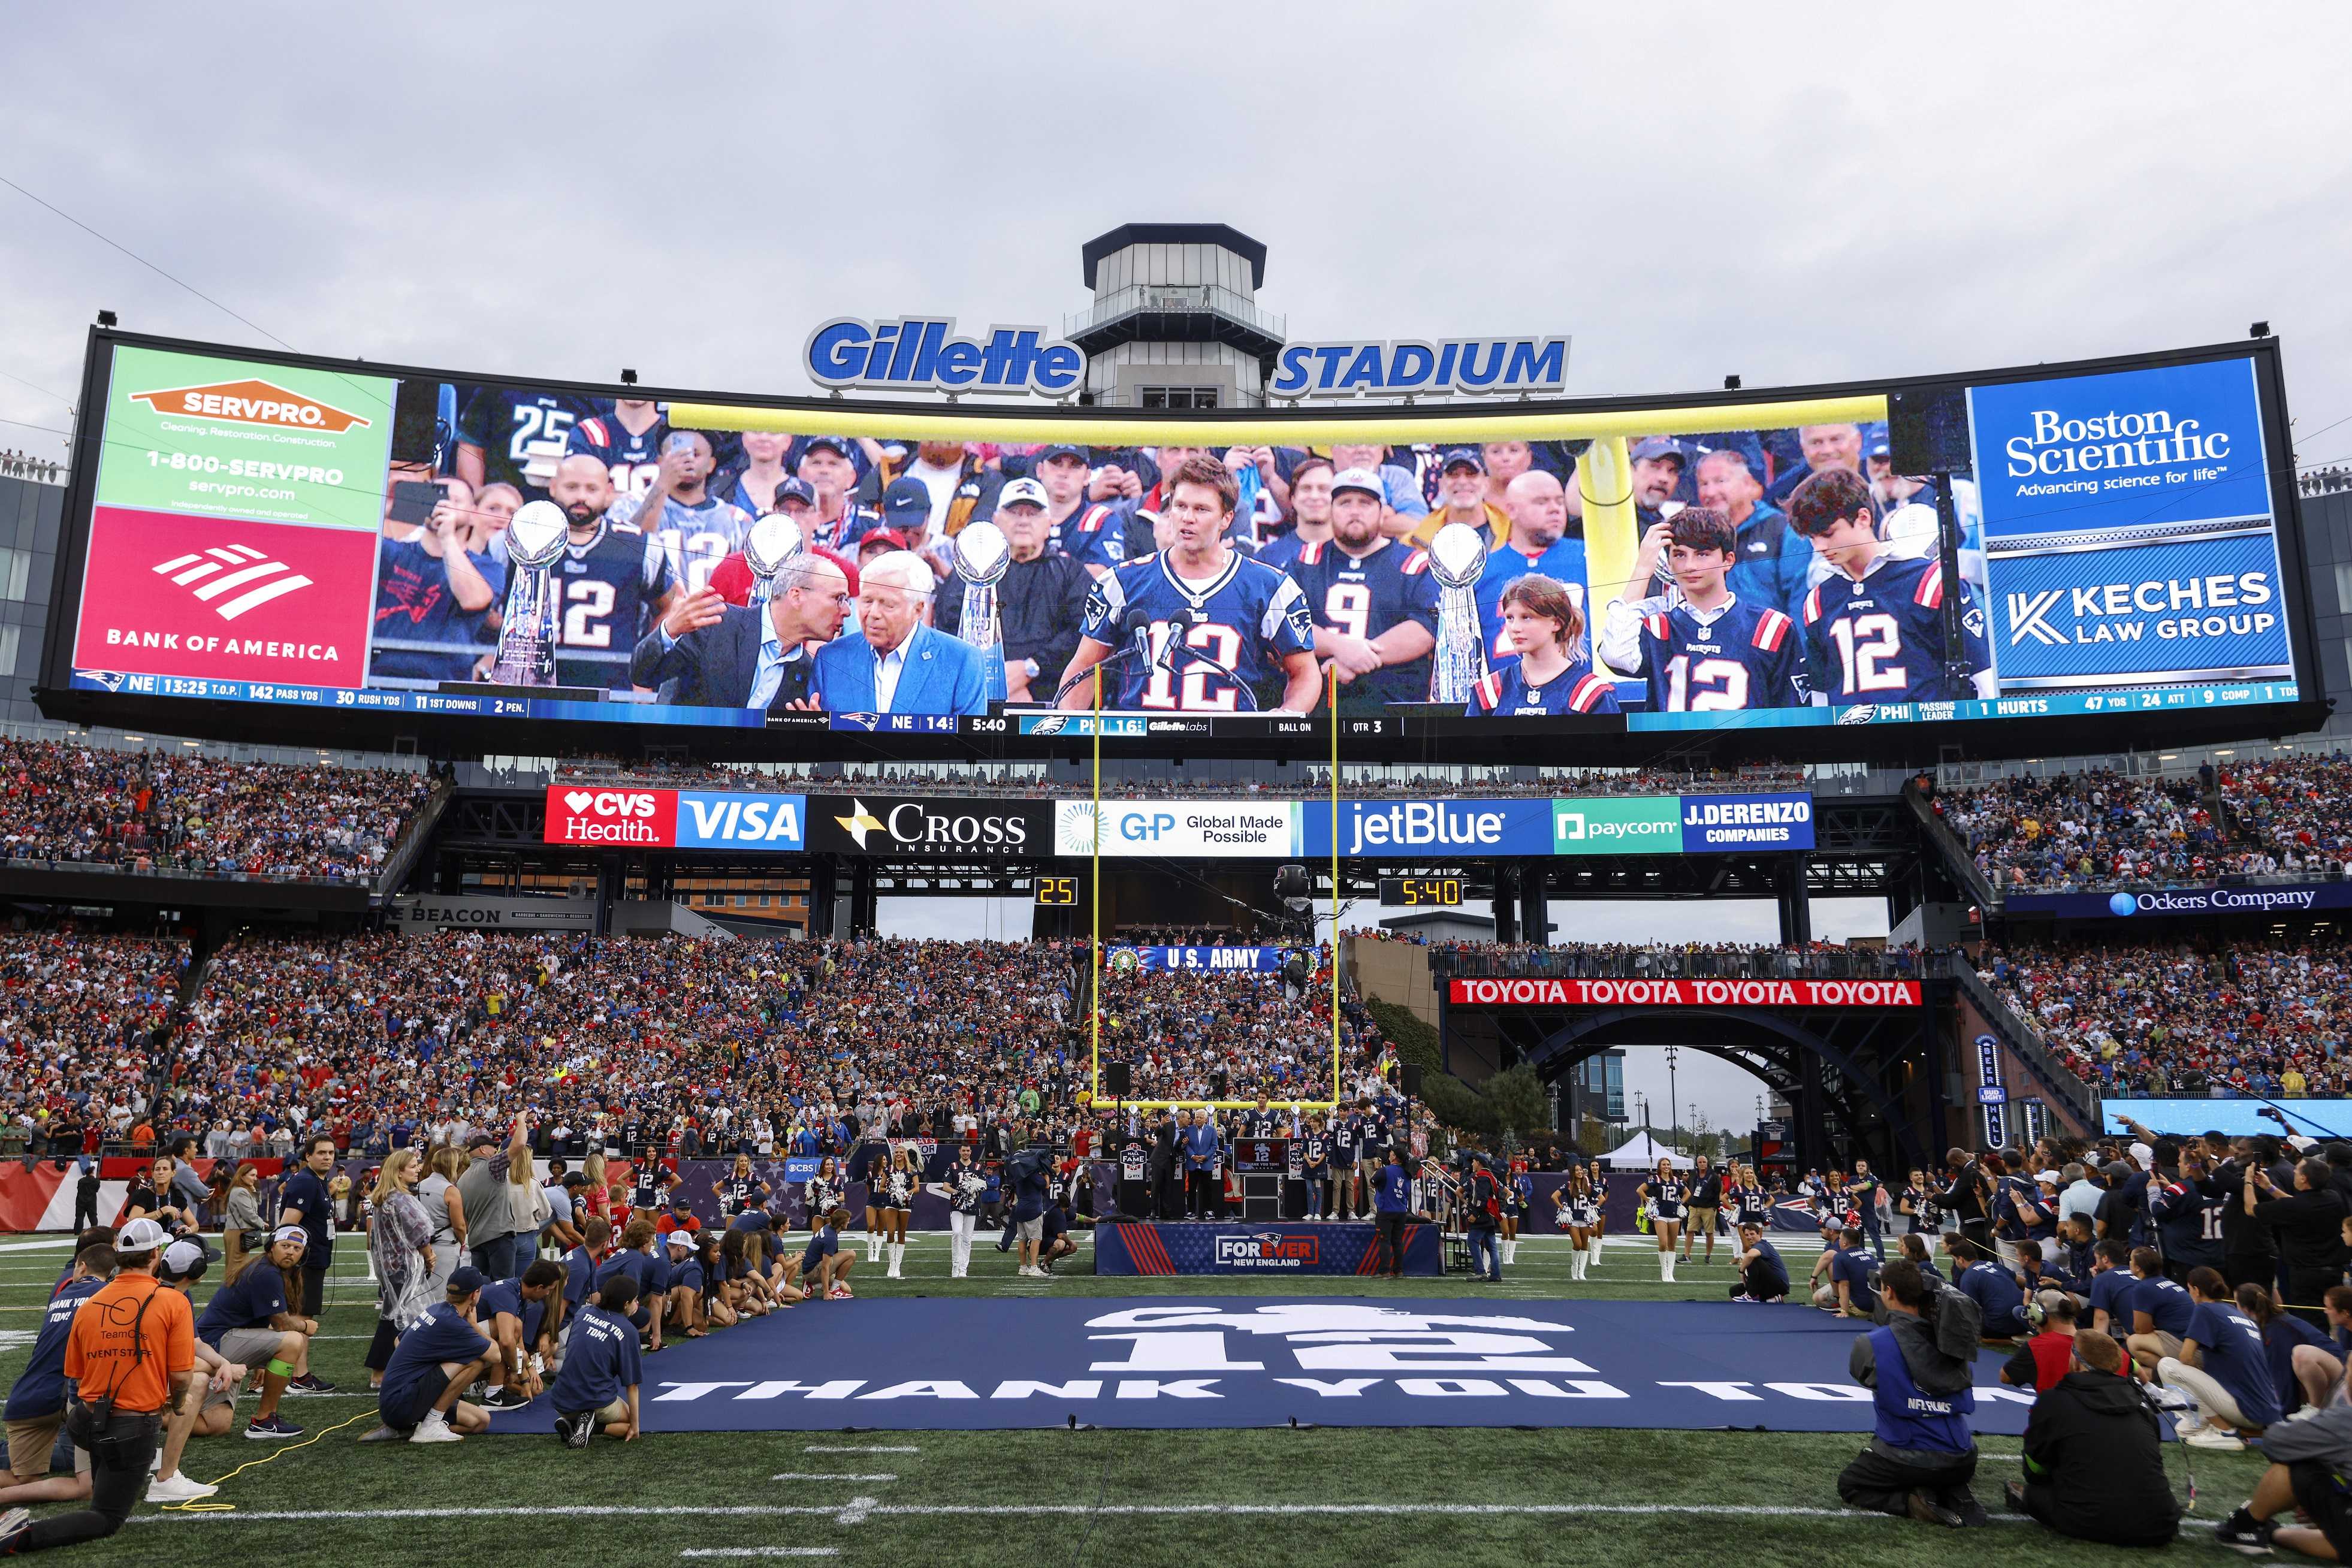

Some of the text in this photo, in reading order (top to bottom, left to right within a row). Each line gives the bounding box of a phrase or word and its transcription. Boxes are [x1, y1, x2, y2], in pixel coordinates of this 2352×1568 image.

[810, 322, 1082, 388] Gillette
[1276, 340, 1565, 392] STADIUM
[160, 421, 337, 449] Cleaning. Restoration. Construction.
[2031, 410, 2174, 446] Boston
[2006, 419, 2231, 478] Scientific
[146, 450, 345, 486] 1-800-SERVPRO
[189, 479, 295, 501] servpro.com
[2016, 479, 2099, 497] Advancing
[2104, 473, 2161, 490] science
[2166, 470, 2187, 484] for
[171, 499, 309, 521] Independently owned and operated
[2072, 571, 2272, 618] KECHES
[1324, 582, 1372, 642] 9
[2075, 613, 2275, 645] LAW GROUP
[106, 628, 339, 661] BANK OF AMERICA
[1829, 613, 1908, 696] 12
[1142, 620, 1243, 712] 12
[128, 675, 155, 691] NE
[164, 678, 207, 695] 13:25
[1666, 655, 1750, 712] 12
[249, 684, 318, 702] 142 PASS YDS
[336, 690, 400, 706] 30 RUSH YDS
[2141, 693, 2185, 708] 24 ATT
[2203, 690, 2251, 703] 9 COMP
[2265, 686, 2274, 700] 1
[415, 696, 478, 711] 11 1ST DOWNS
[494, 700, 526, 714] 2 PEN.
[1514, 707, 1547, 717] PATRIOTS
[1880, 705, 1909, 720] PHI
[1918, 702, 1955, 712] PASSING
[1981, 700, 2048, 715] 1 HURTS
[2084, 696, 2127, 711] 47 YDS
[892, 715, 913, 730] NE
[972, 718, 1007, 732] 5:40
[1922, 711, 1954, 721] LEADER
[1116, 720, 1138, 734] 16
[1278, 722, 1312, 732] BALL ON
[1352, 720, 1382, 733] QTR 3
[594, 793, 656, 817] CVS
[683, 800, 800, 841] VISA
[887, 803, 1026, 844] CROSS
[1186, 815, 1284, 830] Global Made
[1349, 802, 1502, 855] jetBlue
[1589, 819, 1672, 839] paycom
[1203, 829, 1267, 844] Possible
[1706, 828, 1790, 843] COMPANIES
[895, 844, 1025, 854] INSURANCE
[1040, 879, 1071, 904] 25
[1403, 880, 1458, 904] 5:40
[2136, 890, 2317, 912] Ockers Company
[411, 908, 501, 923] BEACON
[1168, 948, 1260, 969] U.S. ARMY
[1461, 980, 1568, 1004] TOYOTA
[1576, 981, 1683, 1004] TOYOTA
[1691, 981, 1798, 1005] TOYOTA
[1806, 981, 1913, 1005] TOYOTA
[1983, 1047, 1994, 1084] BEER
[1255, 1119, 1270, 1138] 12
[1363, 1124, 1377, 1139] 12
[1989, 1105, 2000, 1143] HALL
[627, 1131, 637, 1143] 12
[707, 1132, 716, 1143] 12
[1336, 1130, 1351, 1148] 12
[1255, 1151, 1270, 1162] 12
[1308, 1141, 1323, 1159] 12
[796, 1164, 814, 1173] CBS
[639, 1173, 654, 1190] 12
[732, 1184, 748, 1200] 12
[1050, 1183, 1064, 1200] 12
[1662, 1185, 1677, 1201] 12
[1744, 1195, 1761, 1210] 12
[1832, 1198, 1847, 1214] 12
[1221, 1241, 1311, 1258] FOREVER
[1255, 1259, 1300, 1267] ENGLAND
[50, 1311, 72, 1323] TOM!
[582, 1312, 624, 1342] THANK YOU
[586, 1325, 607, 1342] TOM!
[1087, 1331, 1601, 1373] 12
[651, 1379, 1226, 1401] THANK
[1272, 1378, 1631, 1398] YOU
[1907, 1397, 1952, 1413] NFL FILMS
